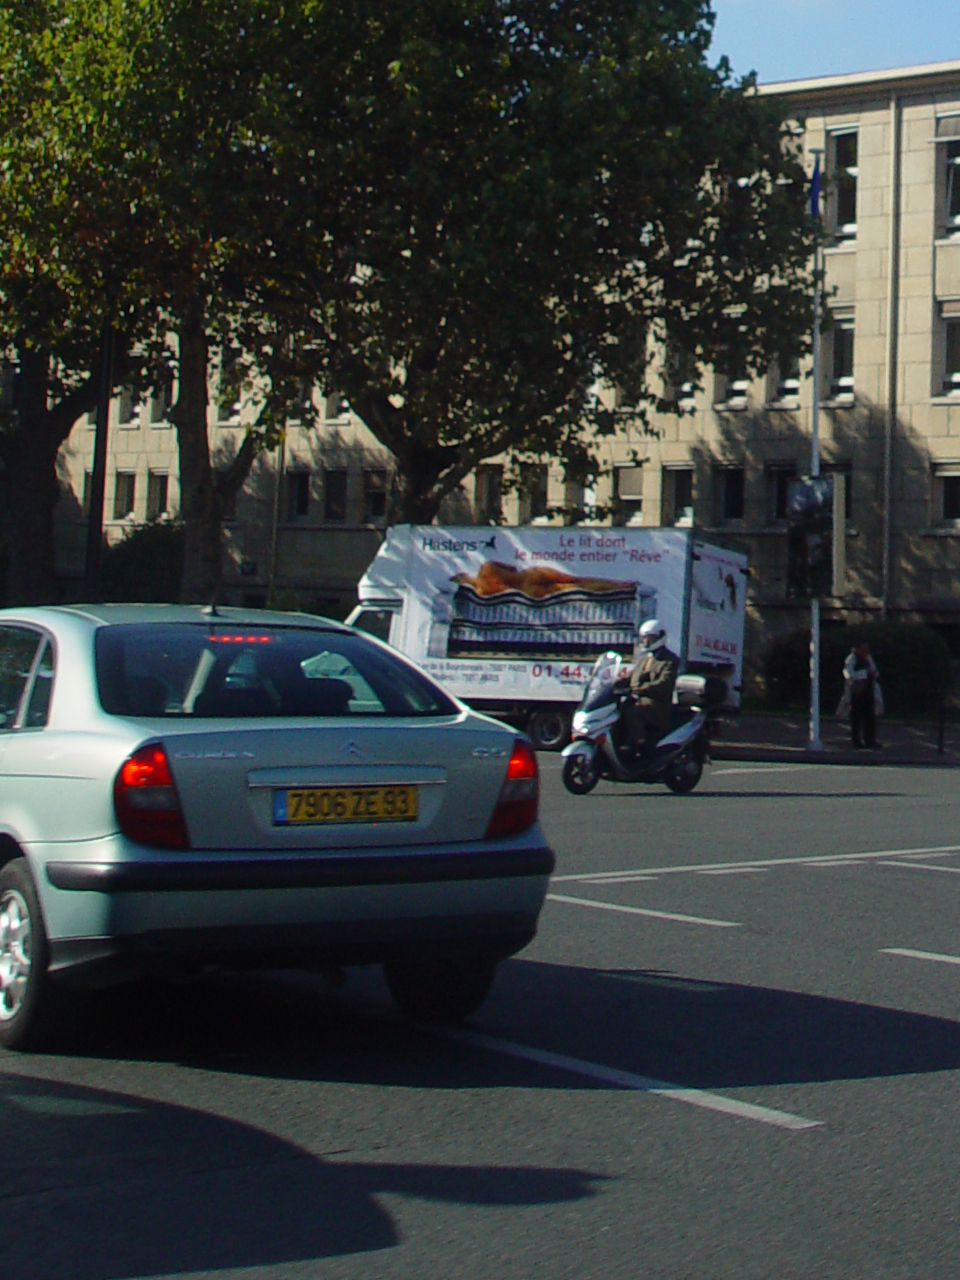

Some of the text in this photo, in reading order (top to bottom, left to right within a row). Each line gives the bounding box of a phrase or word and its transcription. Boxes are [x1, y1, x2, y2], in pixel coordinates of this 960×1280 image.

[559, 534, 626, 549] Le lit dont
[514, 548, 527, 560] le
[531, 548, 575, 562] monde
[579, 550, 618, 563] entier
[290, 789, 409, 817] 7906 ZE 93
